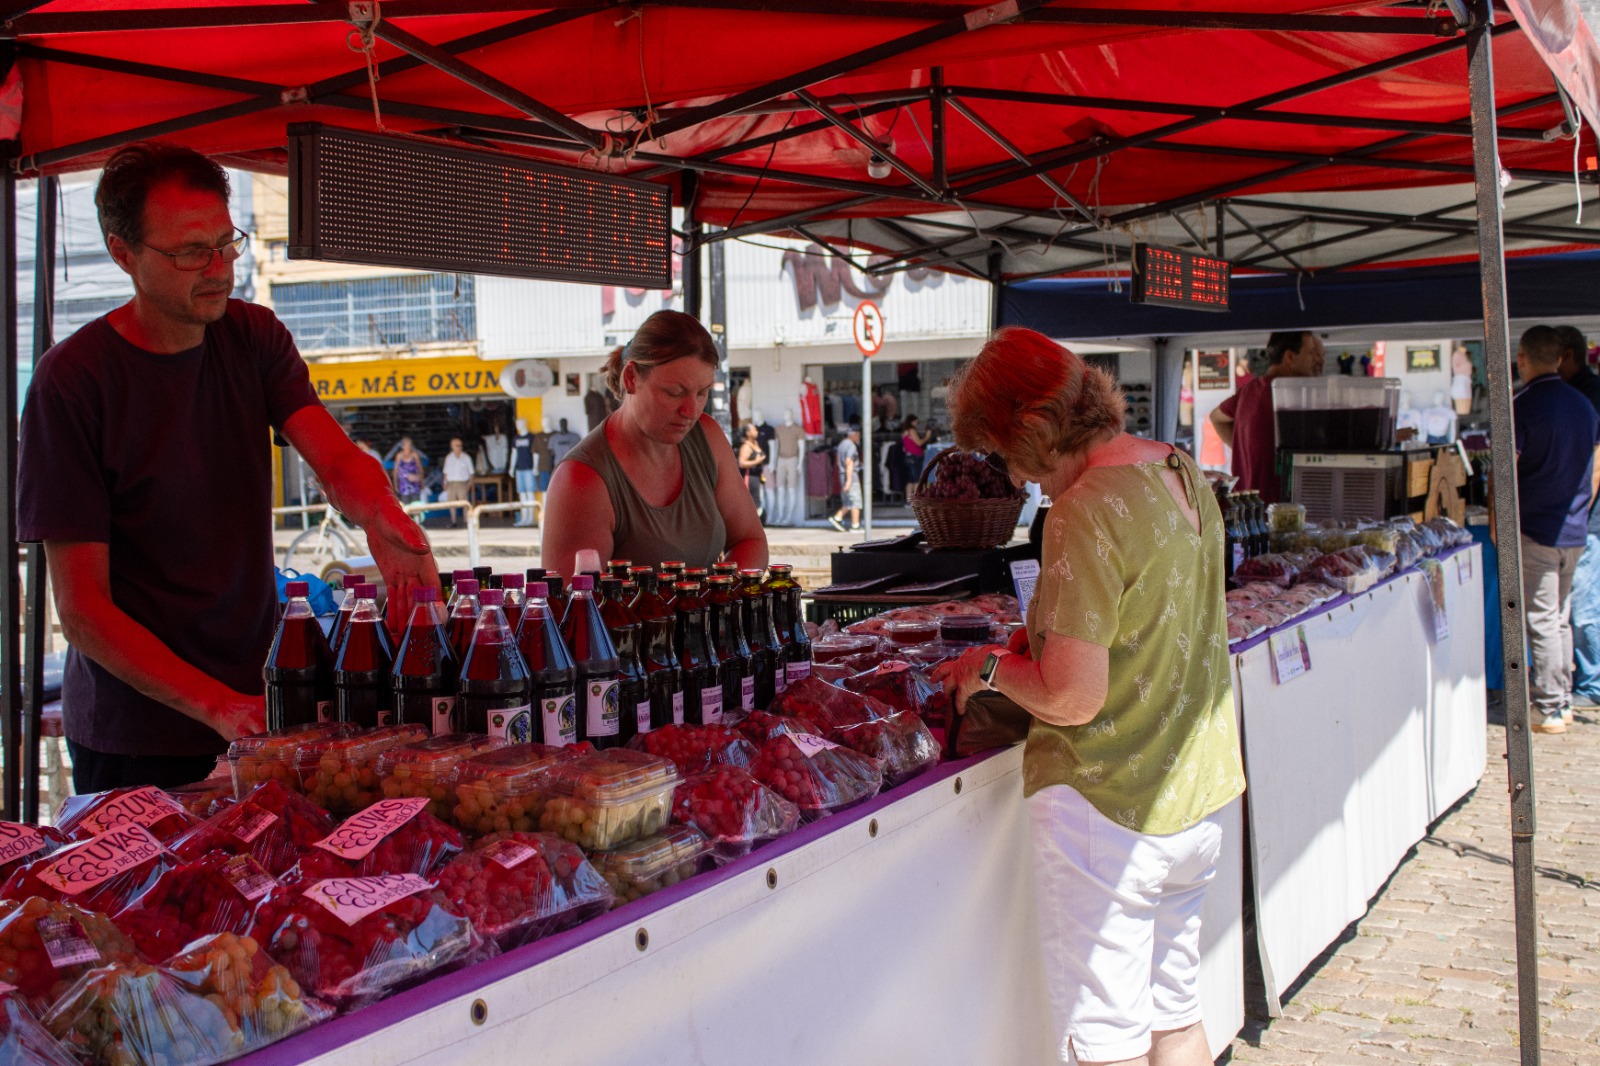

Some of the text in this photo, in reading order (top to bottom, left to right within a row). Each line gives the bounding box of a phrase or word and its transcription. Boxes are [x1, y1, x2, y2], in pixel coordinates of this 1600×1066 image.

[864, 315, 873, 341] E
[317, 379, 348, 395] RA
[348, 801, 405, 829] UVAS
[0, 831, 45, 860] PELOTAS
[84, 826, 149, 861] UVAS
[114, 843, 158, 867] DE PELO
[387, 877, 428, 896] PELOTA
